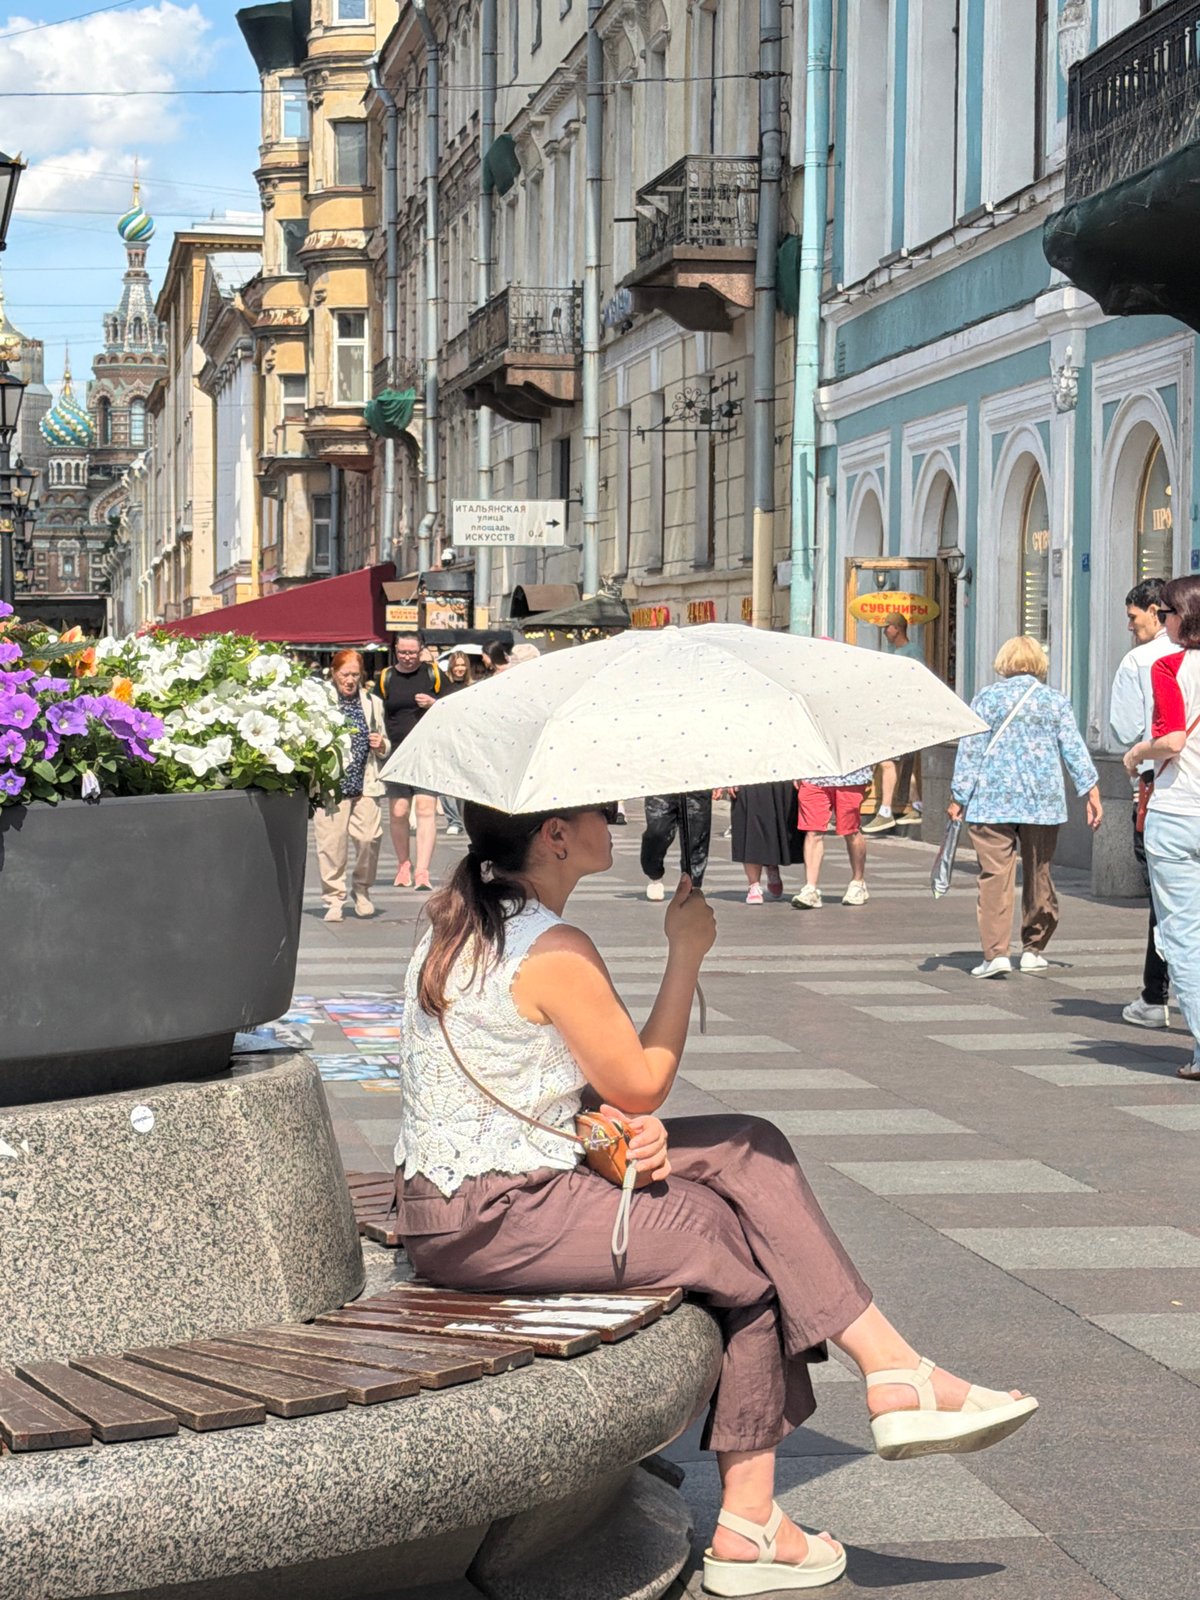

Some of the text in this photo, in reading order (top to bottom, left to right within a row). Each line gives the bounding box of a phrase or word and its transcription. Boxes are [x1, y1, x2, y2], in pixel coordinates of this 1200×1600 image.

[455, 504, 526, 513] ИТАЛЬЯНСКАЯ
[465, 533, 515, 542] ИСКУССТВ
[860, 602, 929, 615] СУВЕНИРЫ
